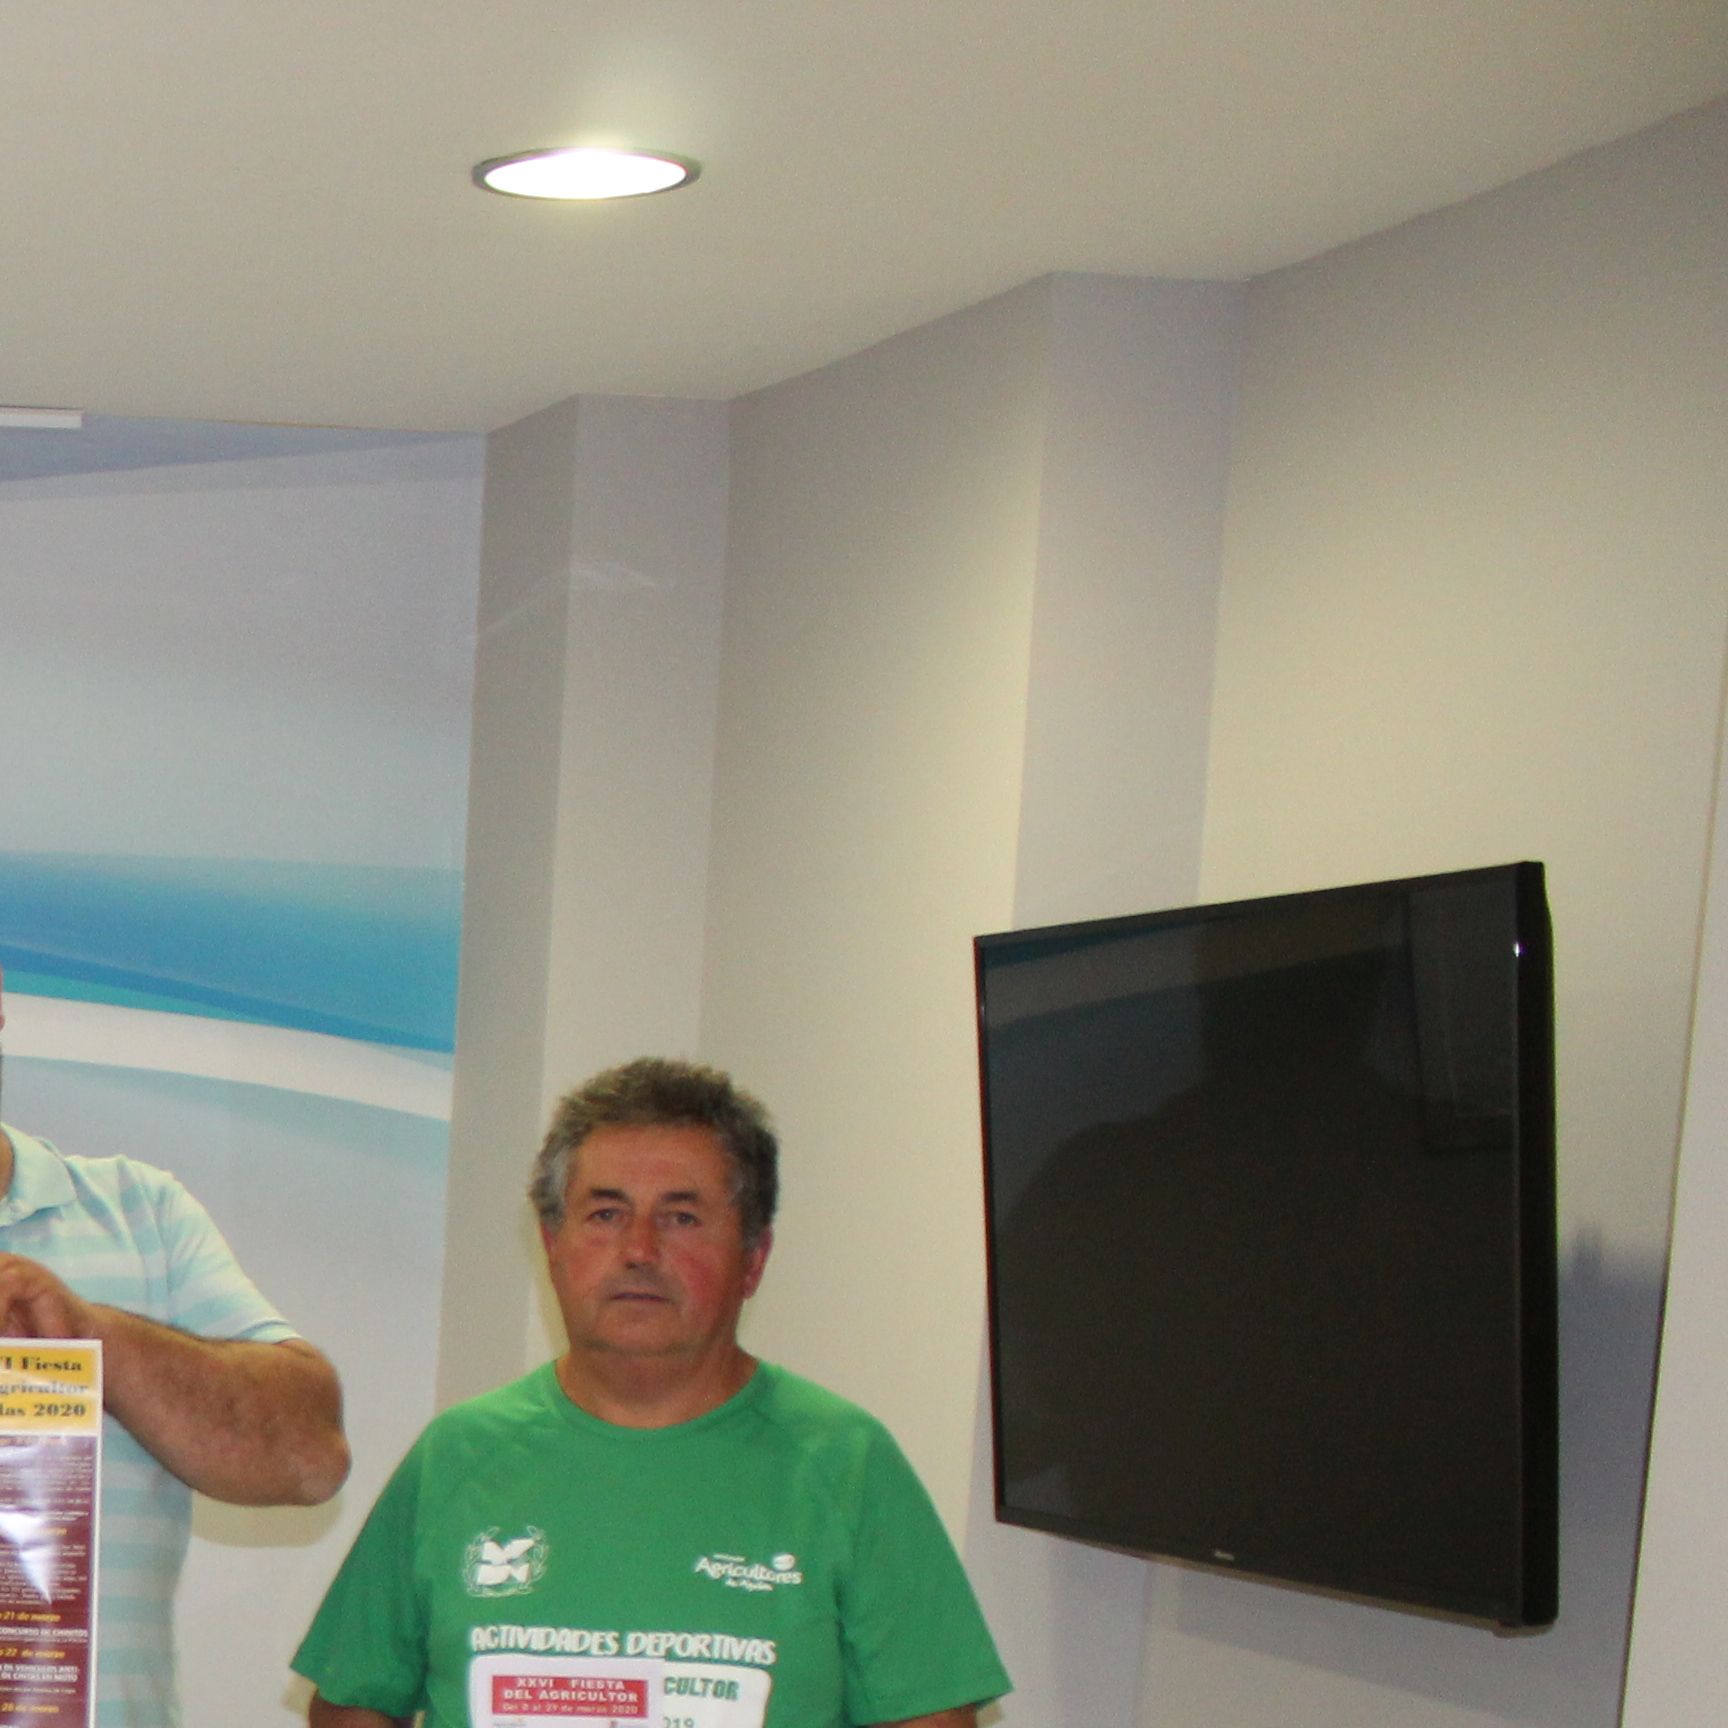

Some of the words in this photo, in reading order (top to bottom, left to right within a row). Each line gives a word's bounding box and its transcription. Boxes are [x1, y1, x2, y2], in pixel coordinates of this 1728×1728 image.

[22, 1356, 82, 1370] Fiesta
[33, 1402, 86, 1417] 2020
[472, 1625, 620, 1656] ACTIVIDADES
[626, 1631, 776, 1665] DEPORTIVAS
[517, 1678, 554, 1688] XXVI
[570, 1679, 624, 1690] FIESTA
[663, 1675, 740, 1701] CULTOR
[504, 1689, 532, 1699] DEL
[539, 1690, 638, 1702] AGRICULTOR
